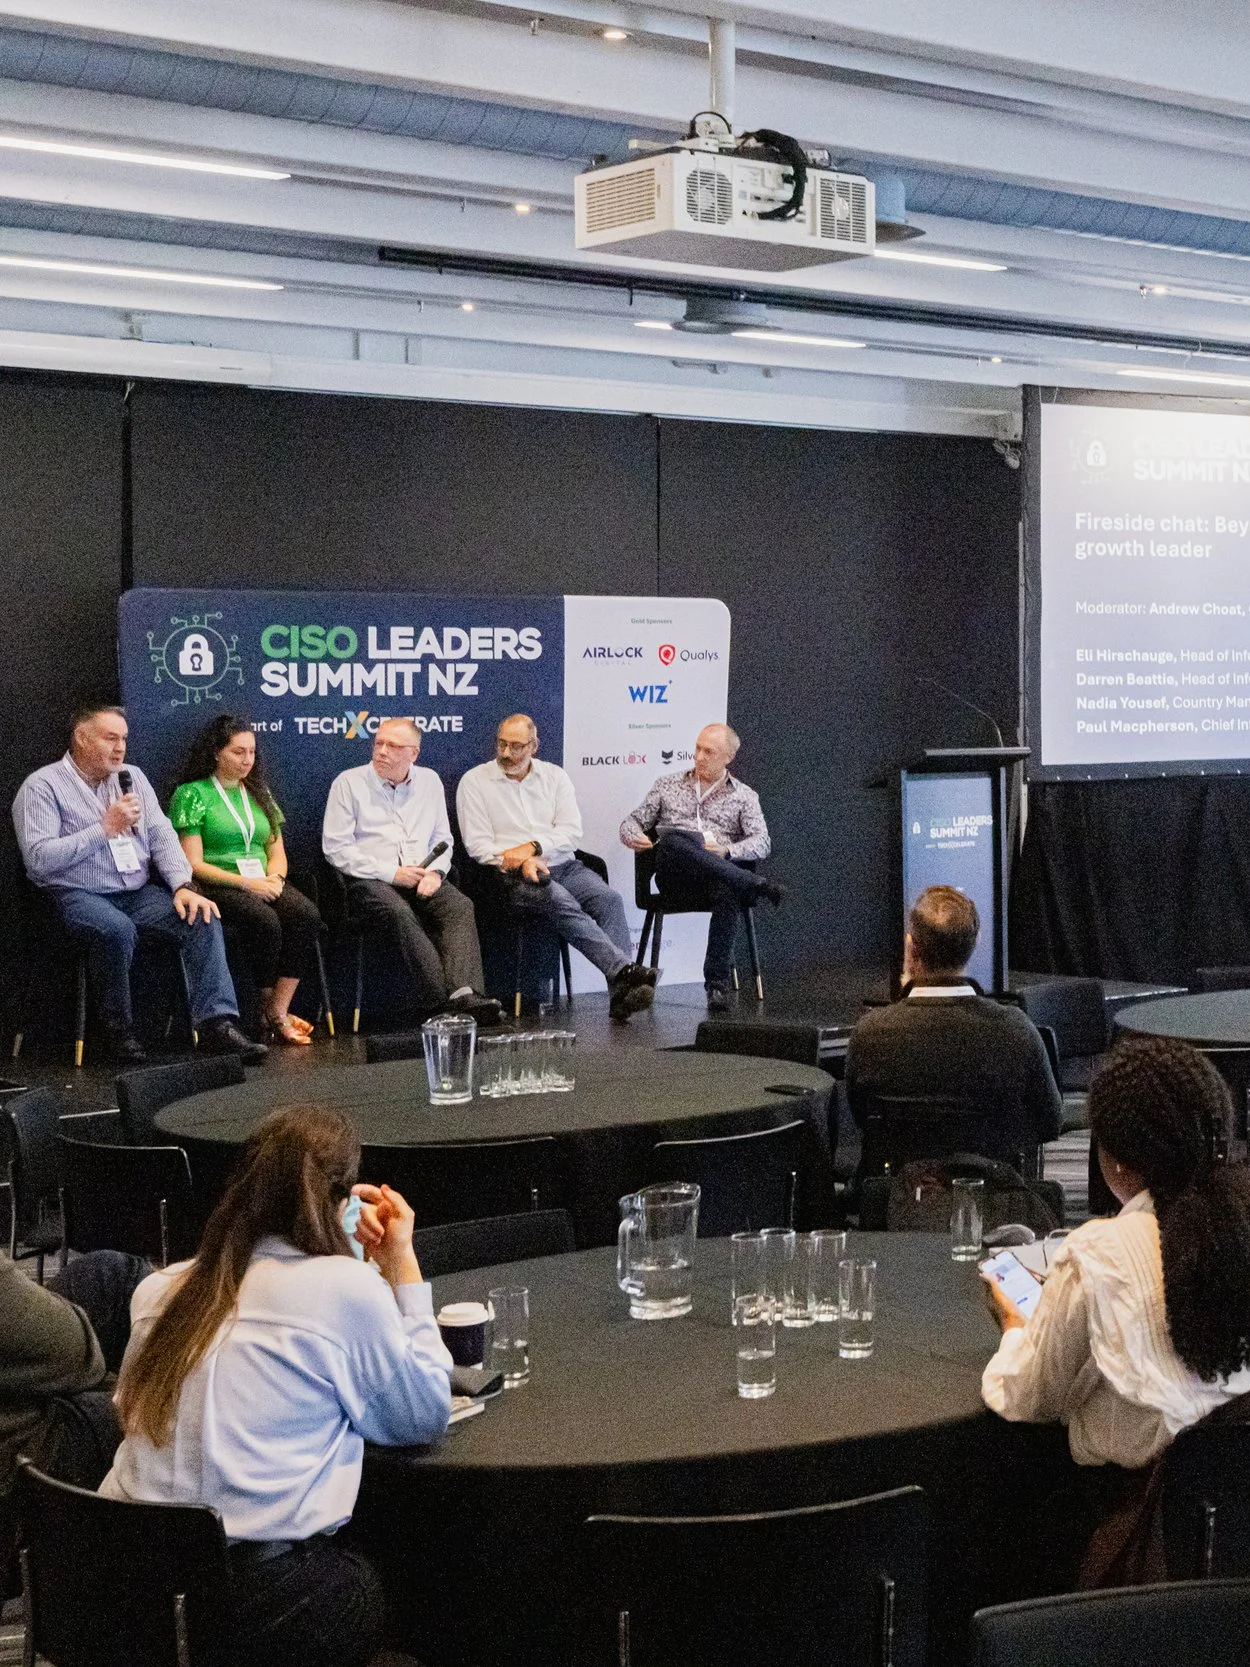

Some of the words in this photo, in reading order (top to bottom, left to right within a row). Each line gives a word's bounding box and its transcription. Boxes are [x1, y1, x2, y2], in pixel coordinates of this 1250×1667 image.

[1133, 459, 1228, 482] SUMMIT
[1075, 512, 1155, 532] Fireside
[1159, 515, 1209, 533] chat:
[1075, 540, 1145, 561] growth
[1150, 540, 1213, 558] leader
[1075, 601, 1147, 616] Moderator:
[1149, 602, 1200, 616] Andrew
[1202, 603, 1246, 617] Choat,
[260, 624, 359, 660] CISO
[367, 625, 543, 660] LEADERS
[582, 646, 643, 659] AIRLOCK
[680, 649, 719, 663] Qualys
[1076, 649, 1093, 662] Eli
[1096, 649, 1177, 664] Hirschauge,
[1180, 649, 1214, 662] Head
[1216, 649, 1229, 662] of
[260, 661, 422, 697] SUMMIT
[428, 663, 479, 696] NZ
[1076, 672, 1124, 686] Darren
[1127, 672, 1179, 687] Beattie,
[1181, 672, 1215, 685] Head
[1218, 672, 1231, 685] of
[628, 685, 668, 703] WIZ
[1076, 696, 1117, 710] Nadia
[1119, 696, 1170, 711] Yousef,
[1172, 696, 1223, 711] Country
[250, 720, 267, 732] art
[270, 719, 283, 732] of
[294, 711, 463, 739] TECHXCRATE
[1076, 720, 1108, 733] Paul
[1110, 720, 1199, 735] Macpherson,
[1201, 719, 1235, 732] Chief
[582, 755, 620, 766] BLACK
[952, 815, 993, 827] LEADERS
[929, 827, 966, 838] SUMMIT
[966, 826, 979, 837] NZ
